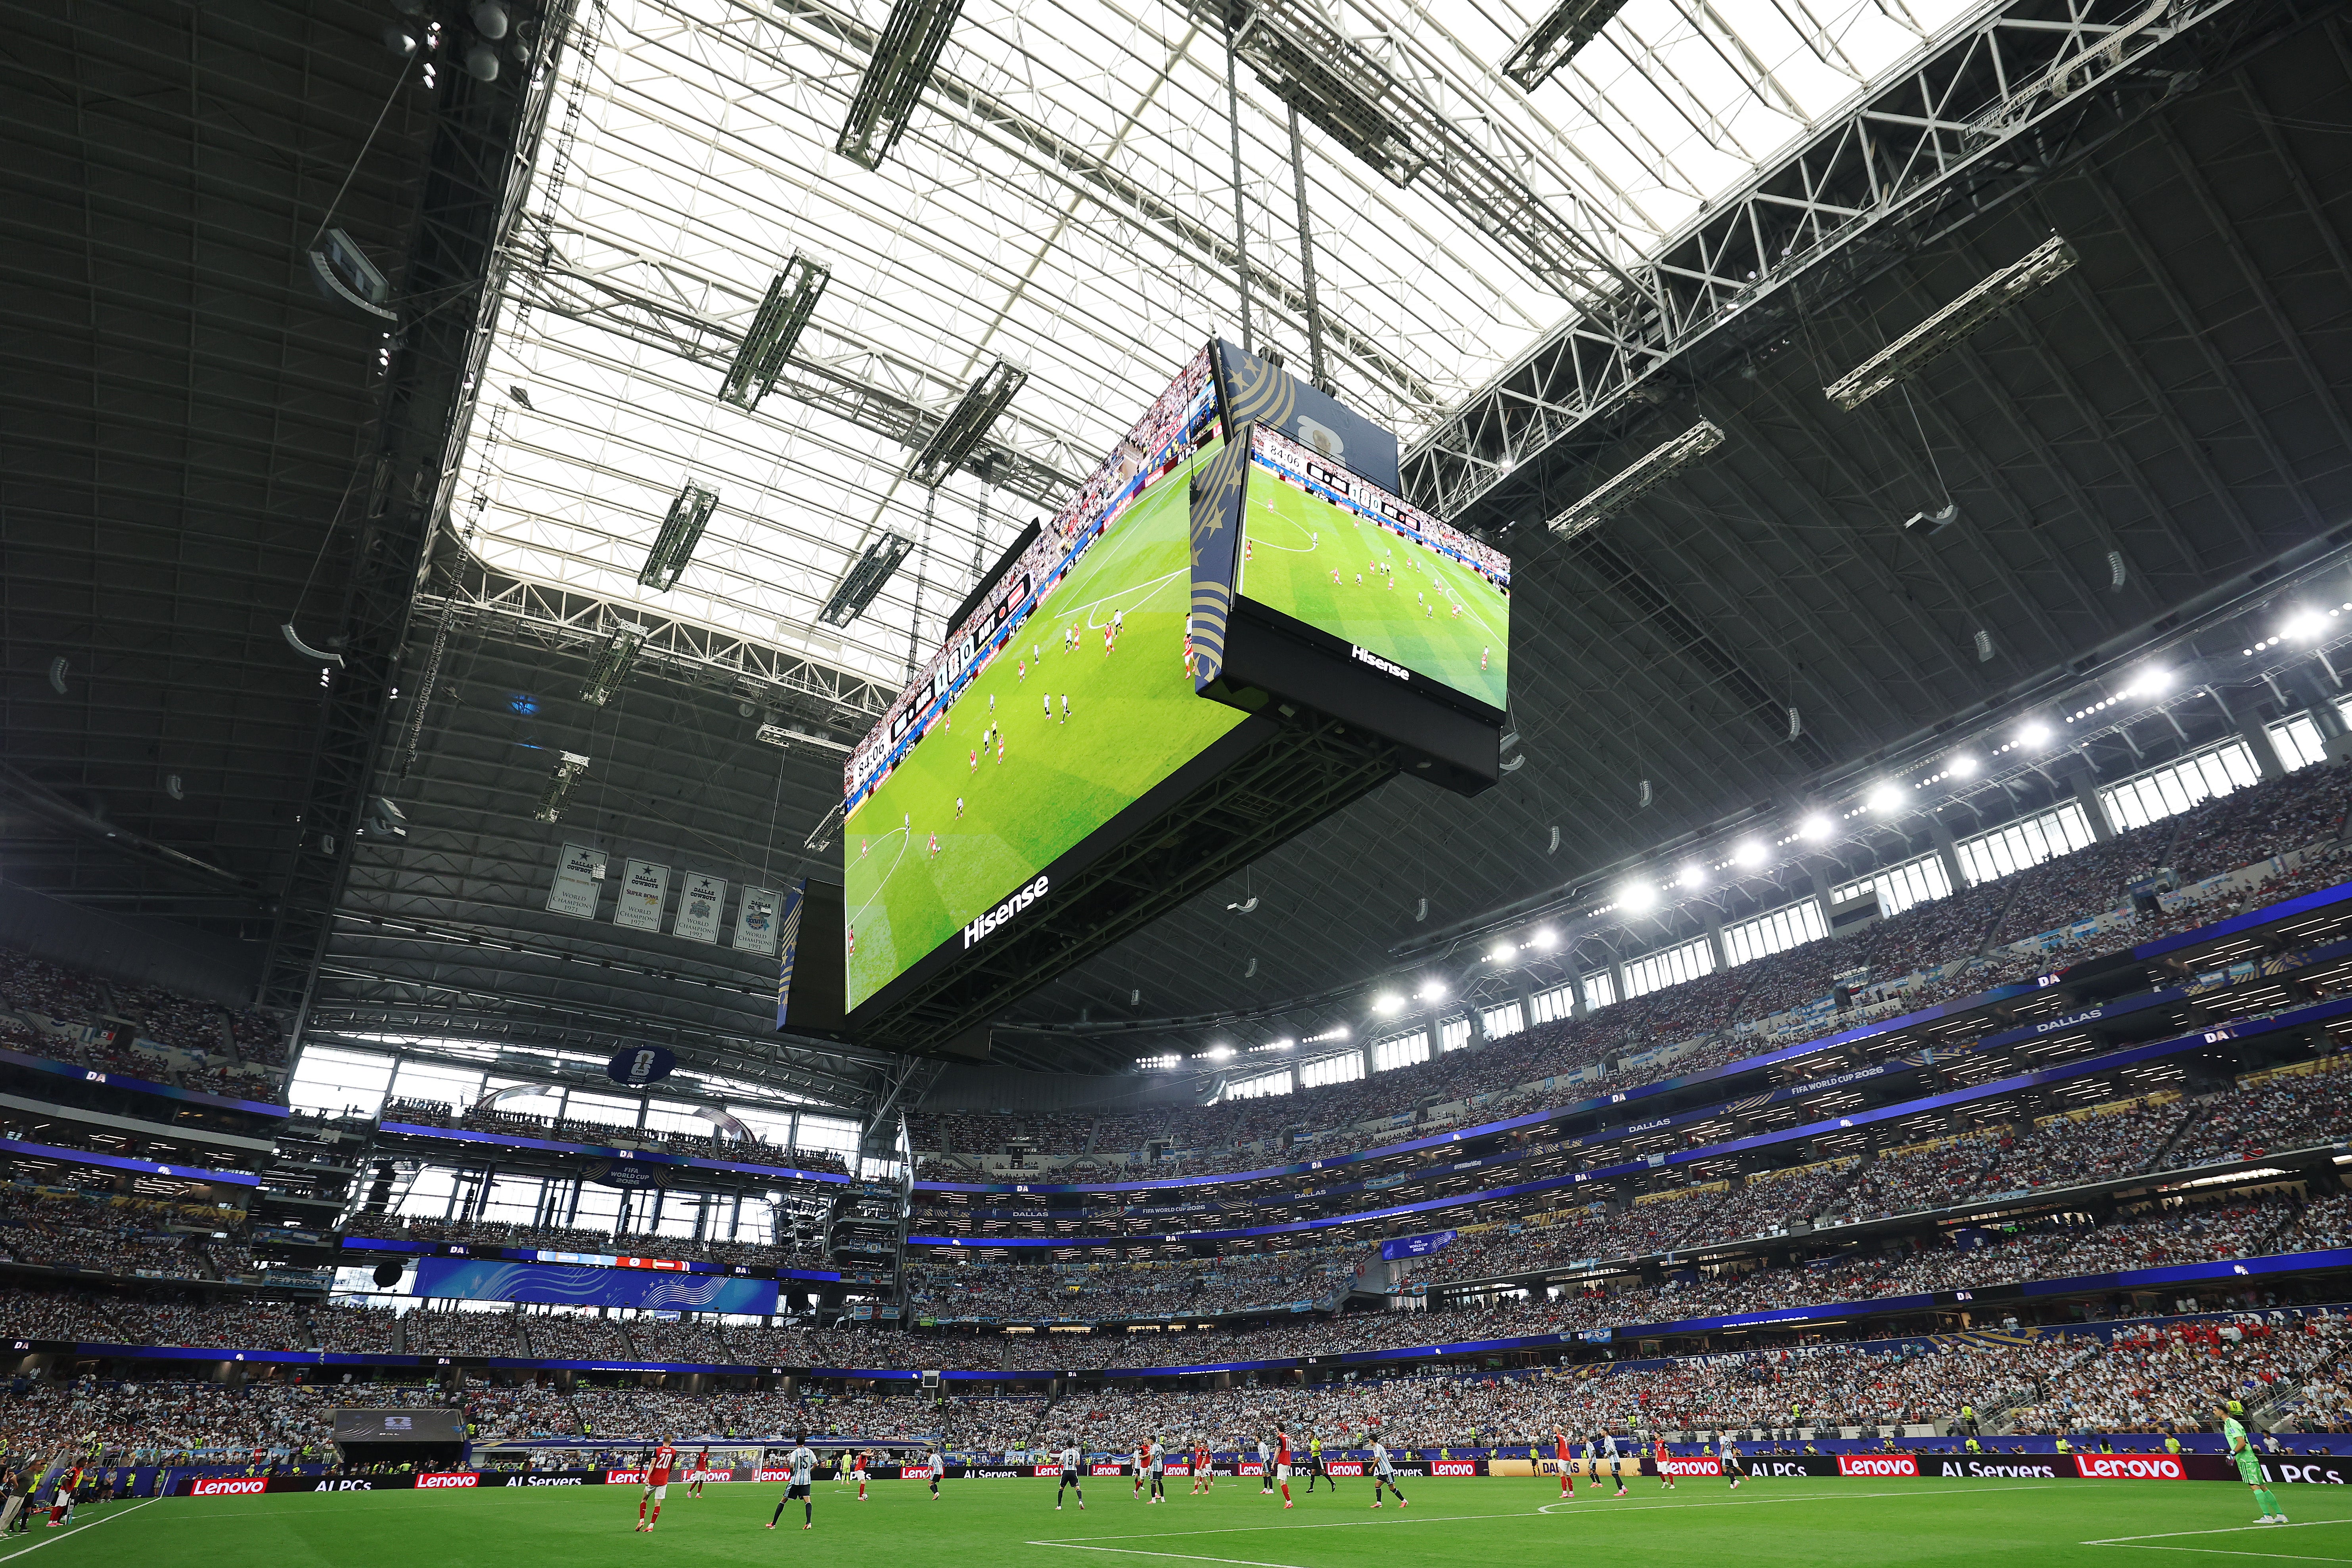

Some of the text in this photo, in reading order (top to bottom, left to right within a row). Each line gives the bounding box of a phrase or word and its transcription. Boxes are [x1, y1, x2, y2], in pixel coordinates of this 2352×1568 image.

[1270, 445, 1299, 467] 84:06
[1145, 470, 1163, 487] Lenovo
[1353, 489, 1356, 497] 1
[1373, 500, 1378, 508] 0
[1104, 496, 1132, 526] Lenovo
[1075, 532, 1099, 562] Servers
[1037, 576, 1060, 607] Lenovo
[979, 613, 996, 645] AUT
[964, 644, 970, 658] 0
[979, 647, 999, 674] Lenovo
[1351, 644, 1410, 681] Hisense
[939, 674, 944, 687] 1
[954, 676, 973, 703] Servers
[916, 686, 932, 713] ARG
[923, 711, 942, 735] Lenovo
[859, 739, 884, 777] 84:06
[873, 768, 892, 791] Lenovo
[567, 864, 593, 874] COWBOY
[571, 860, 593, 869] DALLAS
[631, 879, 659, 889] COWBOYS
[635, 874, 657, 883] DALLAS
[562, 891, 586, 901] WORLD
[690, 891, 716, 902] COWBOYS
[693, 887, 714, 896] DALLAS
[563, 904, 578, 913] 1971
[628, 906, 652, 915] WORLD
[964, 875, 1049, 950] Hisense
[630, 918, 645, 926] 1977
[687, 917, 709, 927] WORLD
[689, 930, 703, 938] 1992
[745, 930, 767, 940] WORLD
[2036, 1009, 2102, 1032] DALLAS
[1792, 1066, 1885, 1095] FIFA WORLD CUP 2026
[1629, 1118, 1671, 1133] DALLAS
[1454, 1160, 1482, 1170] #FIFAWorldCup
[1295, 1189, 1326, 1198] DALLAS
[655, 1453, 672, 1469] 20
[799, 1455, 808, 1469] 15
[1543, 1462, 1580, 1473] DALAS
[1839, 1457, 1915, 1476] Lenovo
[2078, 1455, 2180, 1478] Lenovo
[964, 1469, 1017, 1479] AI Servers
[1093, 1465, 1120, 1476] Lenovo
[1164, 1466, 1189, 1476] Lenovo
[1295, 1467, 1312, 1476] PCs
[1327, 1463, 1362, 1476] Lenovo
[1392, 1468, 1423, 1476] ervers
[1432, 1462, 1474, 1476] Lenovo
[1669, 1461, 1719, 1475] enovo
[1752, 1463, 1807, 1476] AI PCs
[1942, 1461, 2055, 1478] AI Servers
[2279, 1465, 2344, 1484] PCs
[417, 1474, 476, 1488] Lenovo
[506, 1476, 582, 1487] AI Servers
[754, 1469, 791, 1481] Lenov
[193, 1480, 264, 1495] Lenovo
[315, 1479, 372, 1492] AI PCs
